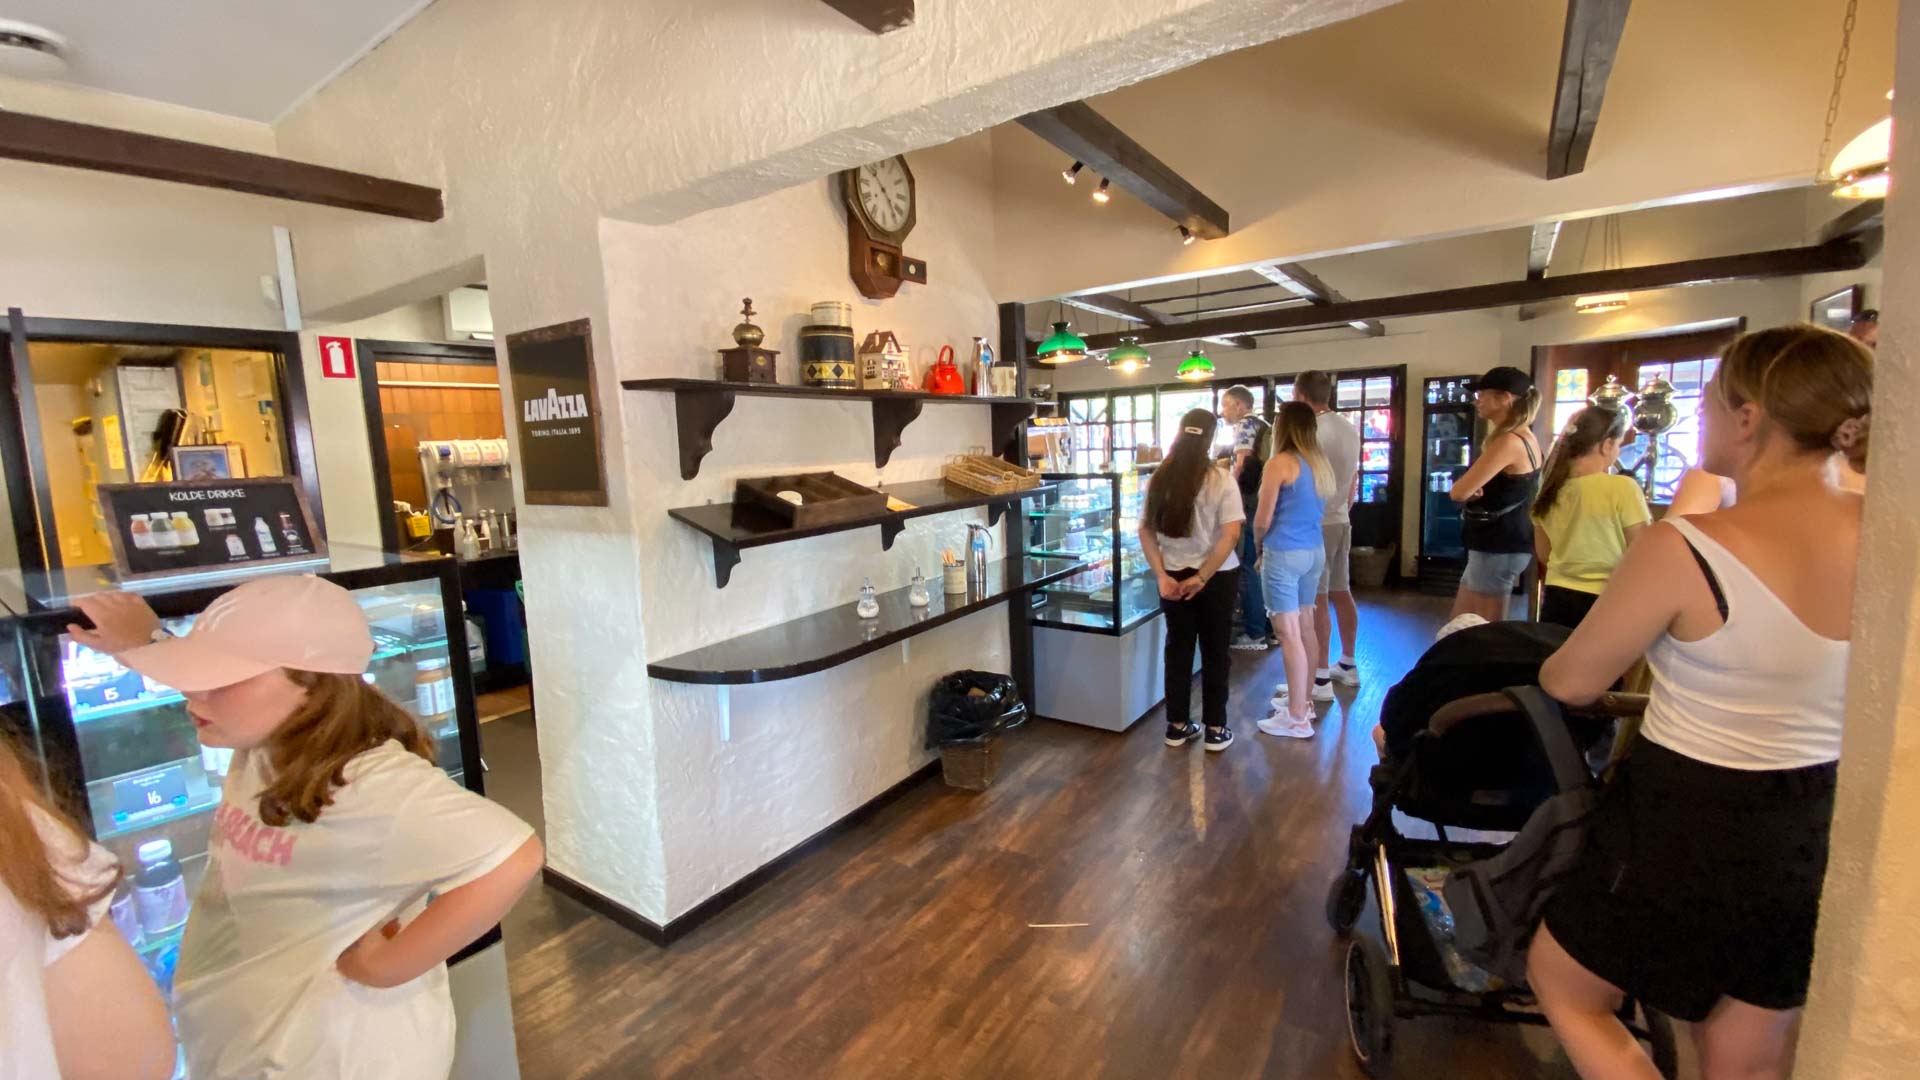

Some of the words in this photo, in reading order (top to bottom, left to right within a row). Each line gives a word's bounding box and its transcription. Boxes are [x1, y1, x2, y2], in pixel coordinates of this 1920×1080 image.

[524, 388, 588, 422] LAVAZZA
[169, 490, 207, 502] KOLDE
[207, 488, 246, 499] DRIKKE
[103, 687, 120, 701] 15
[147, 790, 162, 805] 16
